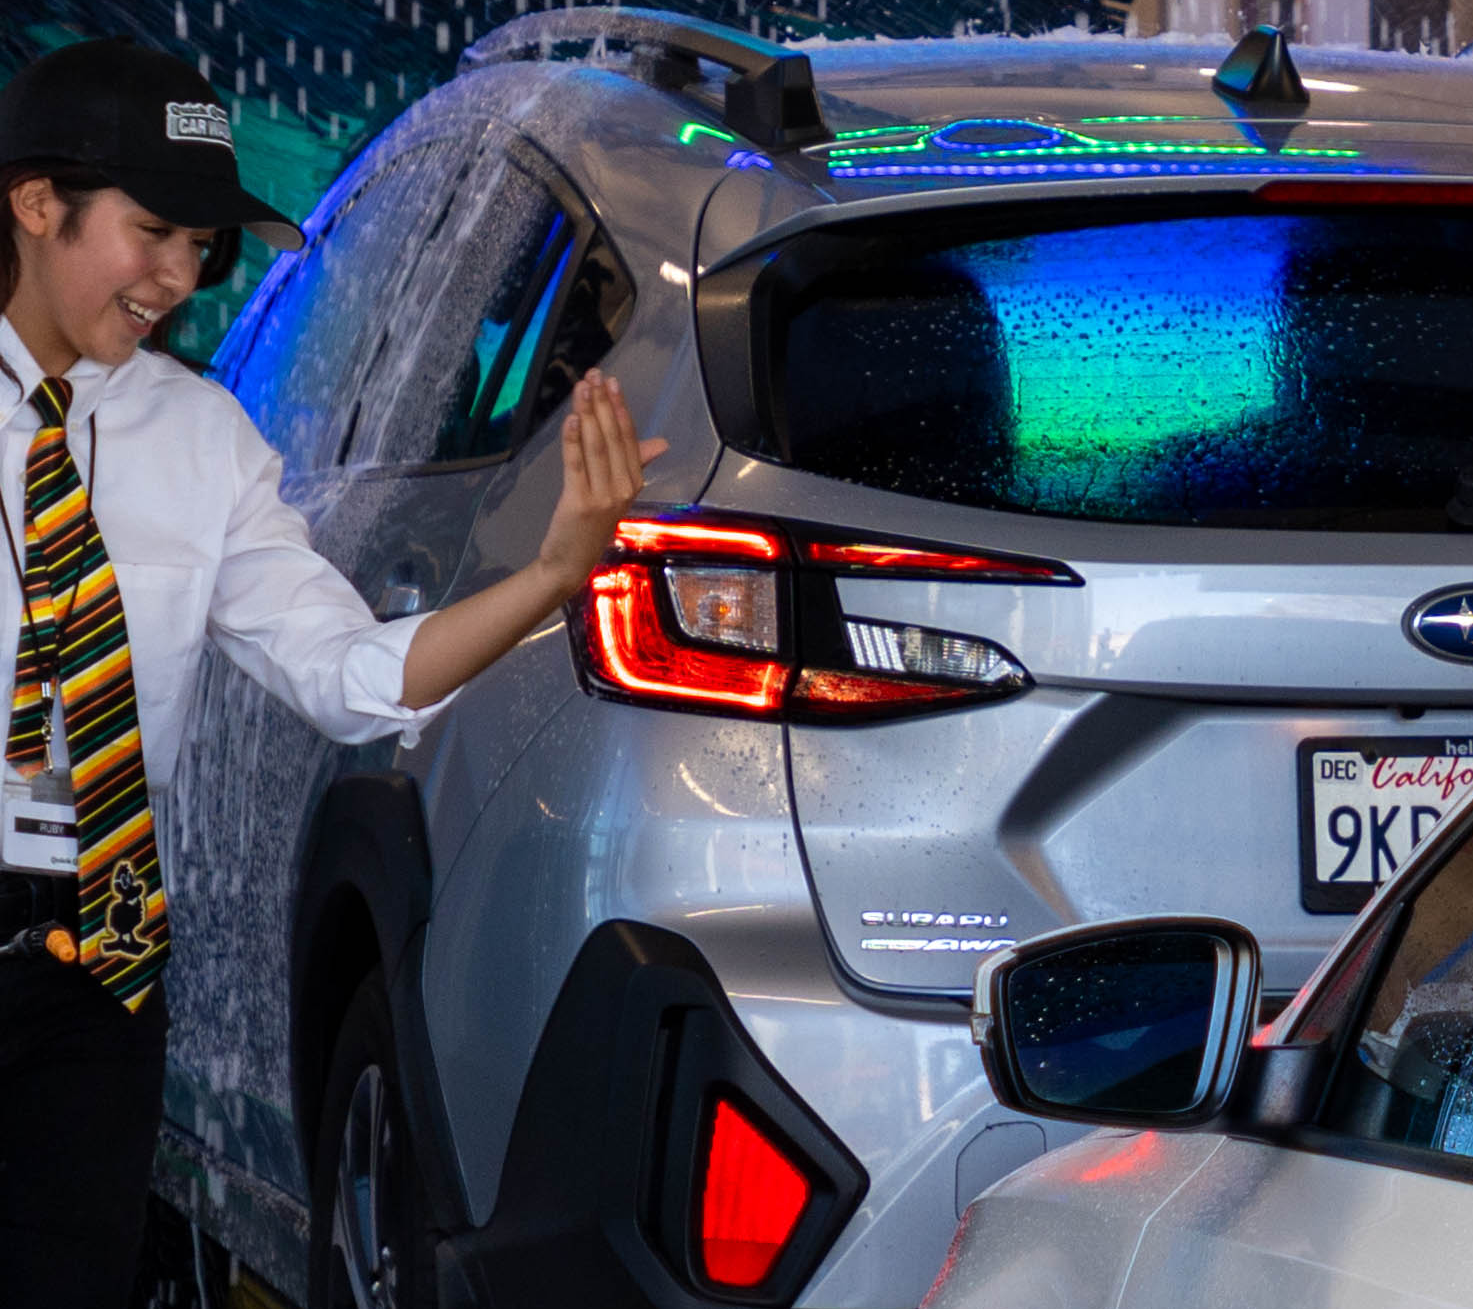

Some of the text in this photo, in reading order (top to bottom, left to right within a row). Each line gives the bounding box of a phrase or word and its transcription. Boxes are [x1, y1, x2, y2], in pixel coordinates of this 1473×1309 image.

[178, 118, 207, 136] CAR
[1321, 759, 1357, 780] DEC
[40, 822, 64, 834] RUBY
[860, 910, 1009, 928] SUBARU
